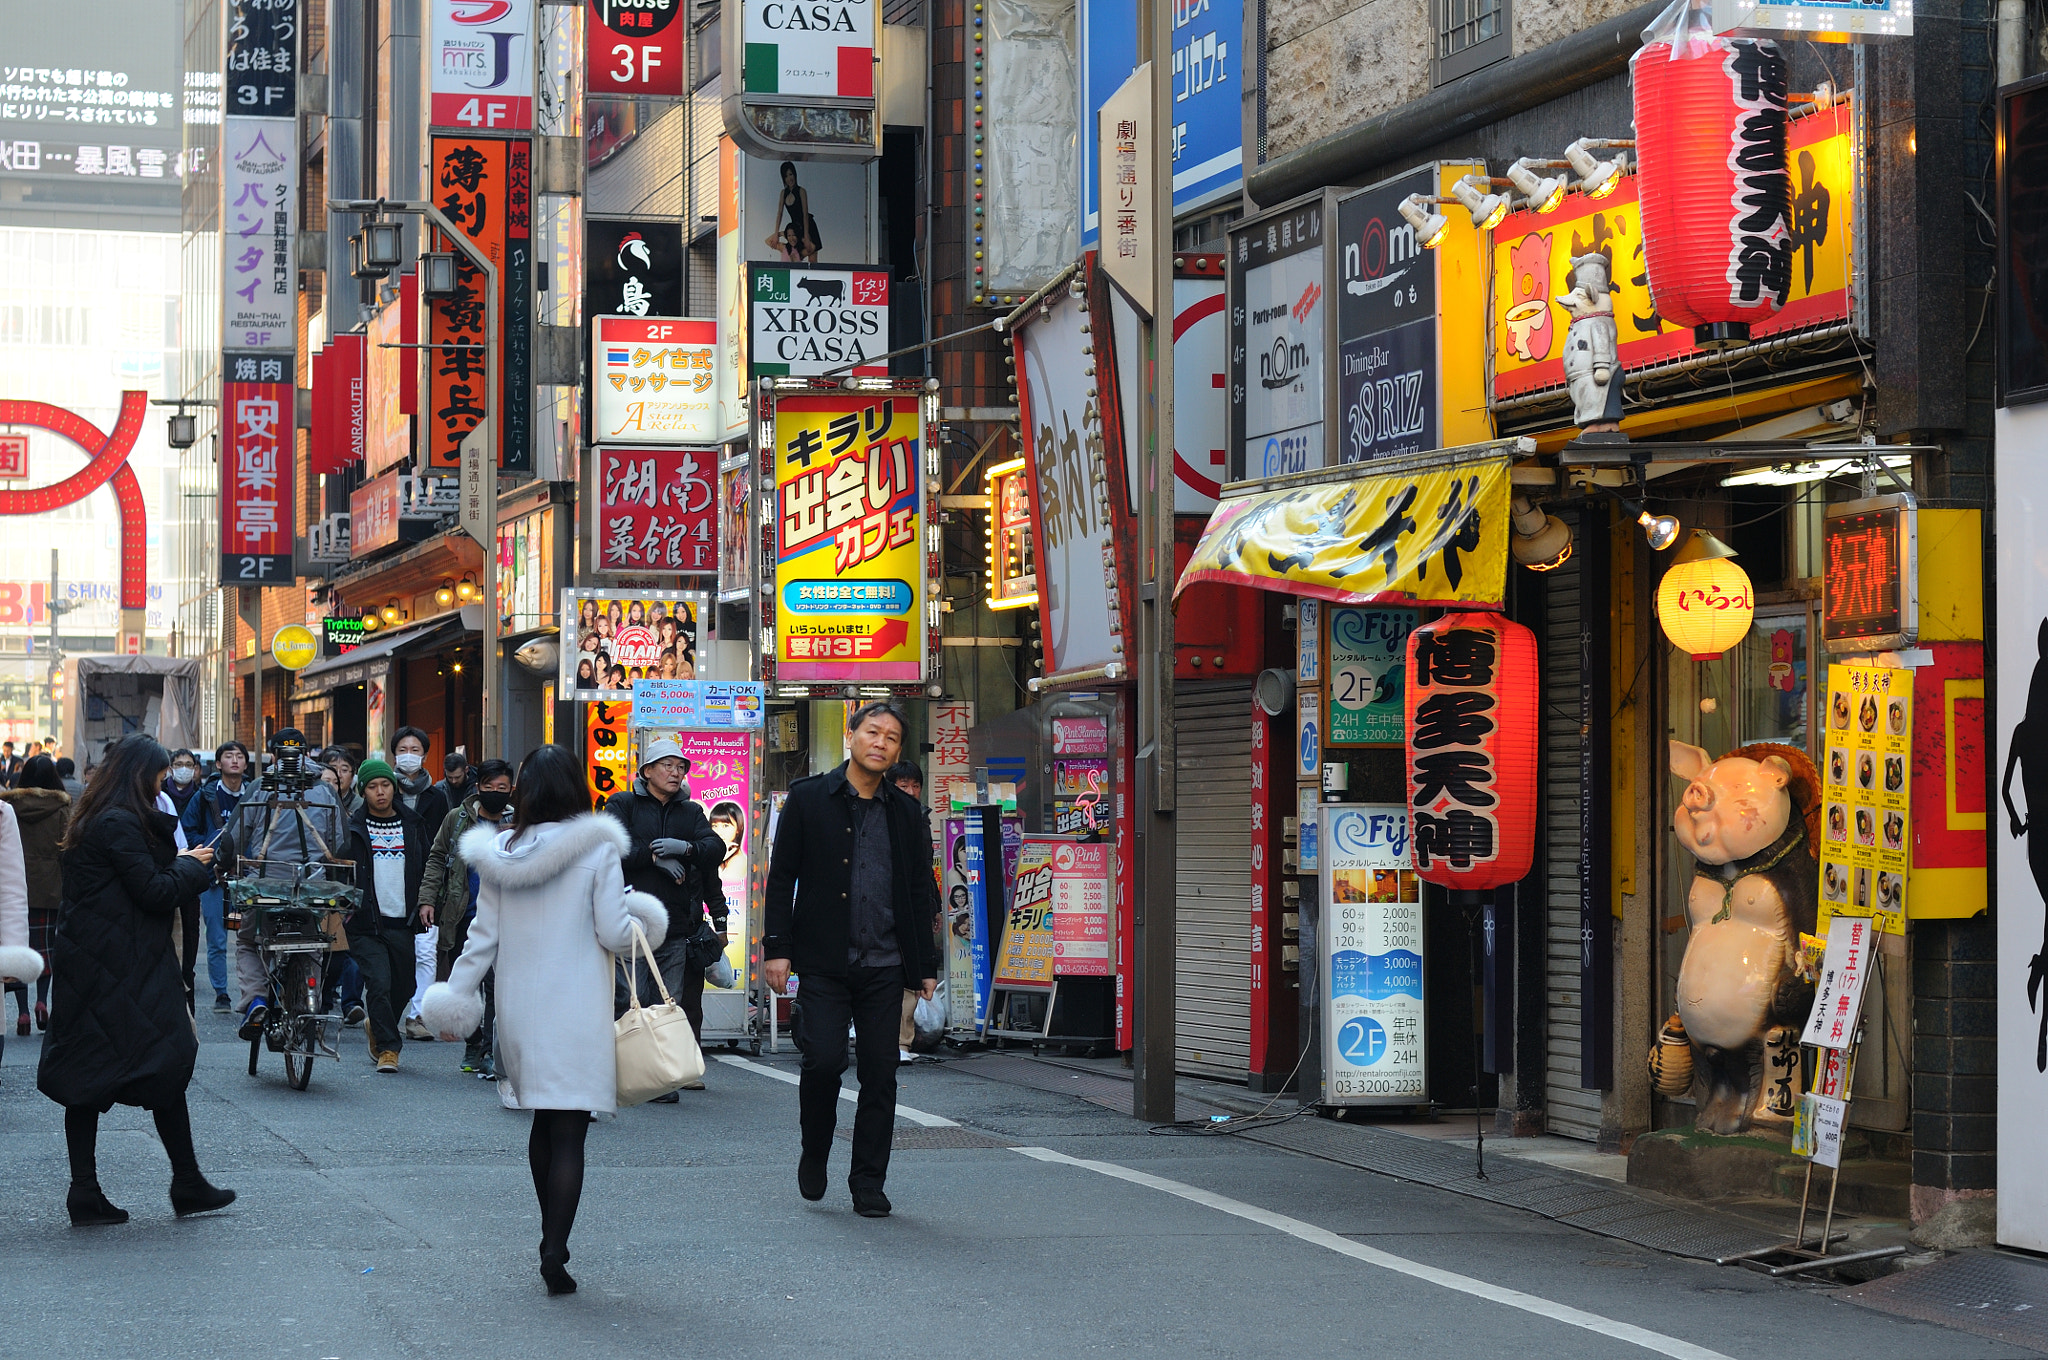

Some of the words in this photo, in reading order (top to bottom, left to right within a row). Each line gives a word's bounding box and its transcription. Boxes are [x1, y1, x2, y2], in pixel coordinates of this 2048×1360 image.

[619, 12, 653, 27] 肉屋
[762, 4, 857, 32] CASA
[610, 44, 662, 82] 3F
[4, 67, 128, 87] ソロでも超ド級の
[785, 69, 832, 78] クロスカーサ
[237, 85, 286, 105] 3F
[0, 103, 158, 126] にリリースされている
[456, 98, 507, 127] 4F
[236, 164, 286, 176] RESTAURANT
[1116, 120, 1137, 258] 劇場通り一番街
[233, 182, 268, 304] バンタイ
[273, 184, 288, 294] タイ国料理専門店
[1238, 209, 1320, 264] 第一桑原ビル
[758, 274, 774, 292] 肉
[769, 293, 789, 301] バル
[1394, 285, 1417, 307] のも
[237, 312, 281, 320] BAN-THAI
[762, 307, 879, 335] XROSS
[1234, 306, 1244, 326] 5F
[1253, 304, 1287, 325] Party-room
[230, 320, 287, 329] RESTAURANT
[647, 325, 673, 339] 2F
[245, 331, 272, 346] 3F
[777, 335, 866, 362] CASA
[1234, 348, 1244, 364] 4F
[632, 348, 713, 370] タイ古式
[1345, 346, 1390, 376] DiningBar
[235, 358, 282, 381] 焼肉
[607, 373, 713, 392] マッサージ
[1234, 387, 1244, 404] 3F
[647, 401, 710, 411] アジアンリラックス
[1377, 370, 1424, 441] RIZ
[351, 377, 363, 456] ANRAKUTEI
[647, 422, 702, 432] Relax
[786, 398, 894, 470] キラリ
[236, 395, 278, 541] 安楽亭
[468, 448, 479, 520] 劇場通り一番街
[606, 452, 713, 514] 湖南
[784, 440, 909, 550] 出会い
[835, 505, 914, 577] カフェ
[239, 557, 274, 578] 2F
[68, 583, 162, 600] SHINU
[799, 585, 896, 599] 女性は全て無料!
[790, 625, 870, 634] いらっしゃいませ!
[790, 637, 873, 657] 受付3F
[660, 690, 695, 699] 5,000円
[709, 685, 757, 695] カードOK!
[1339, 672, 1372, 702] 2F
[661, 706, 695, 715] 7,000円
[1333, 713, 1359, 726] 24H
[688, 736, 711, 747] Aroma
[713, 736, 744, 747] Relaxation
[1412, 628, 1497, 868] 博多天神
[683, 748, 749, 756] アロマリラクゼーション
[690, 758, 746, 782] こゆき
[1583, 752, 1591, 783] Bar
[1096, 803, 1108, 816] 3F
[1075, 845, 1101, 862] Pink
[1251, 721, 1264, 990] 絶対安心宣言!!
[1010, 908, 1043, 930] キラリ
[1342, 908, 1365, 919] 60分
[1383, 908, 1417, 920] 2,000円
[1342, 922, 1365, 933] 90分
[1383, 922, 1417, 934] 2,500円
[1334, 936, 1364, 947] 120分
[1383, 935, 1417, 948] 3,000円
[1384, 958, 1418, 970] 3,000円
[1384, 976, 1418, 989] 4,000円
[1393, 1016, 1417, 1031] 年中
[1344, 1022, 1383, 1057] 2F
[1393, 1031, 1418, 1046] 無休
[1393, 1050, 1418, 1064] 24H
[1336, 1069, 1422, 1079] http://rentalroomfiji.com
[1336, 1080, 1422, 1093] 03-3200-2233
